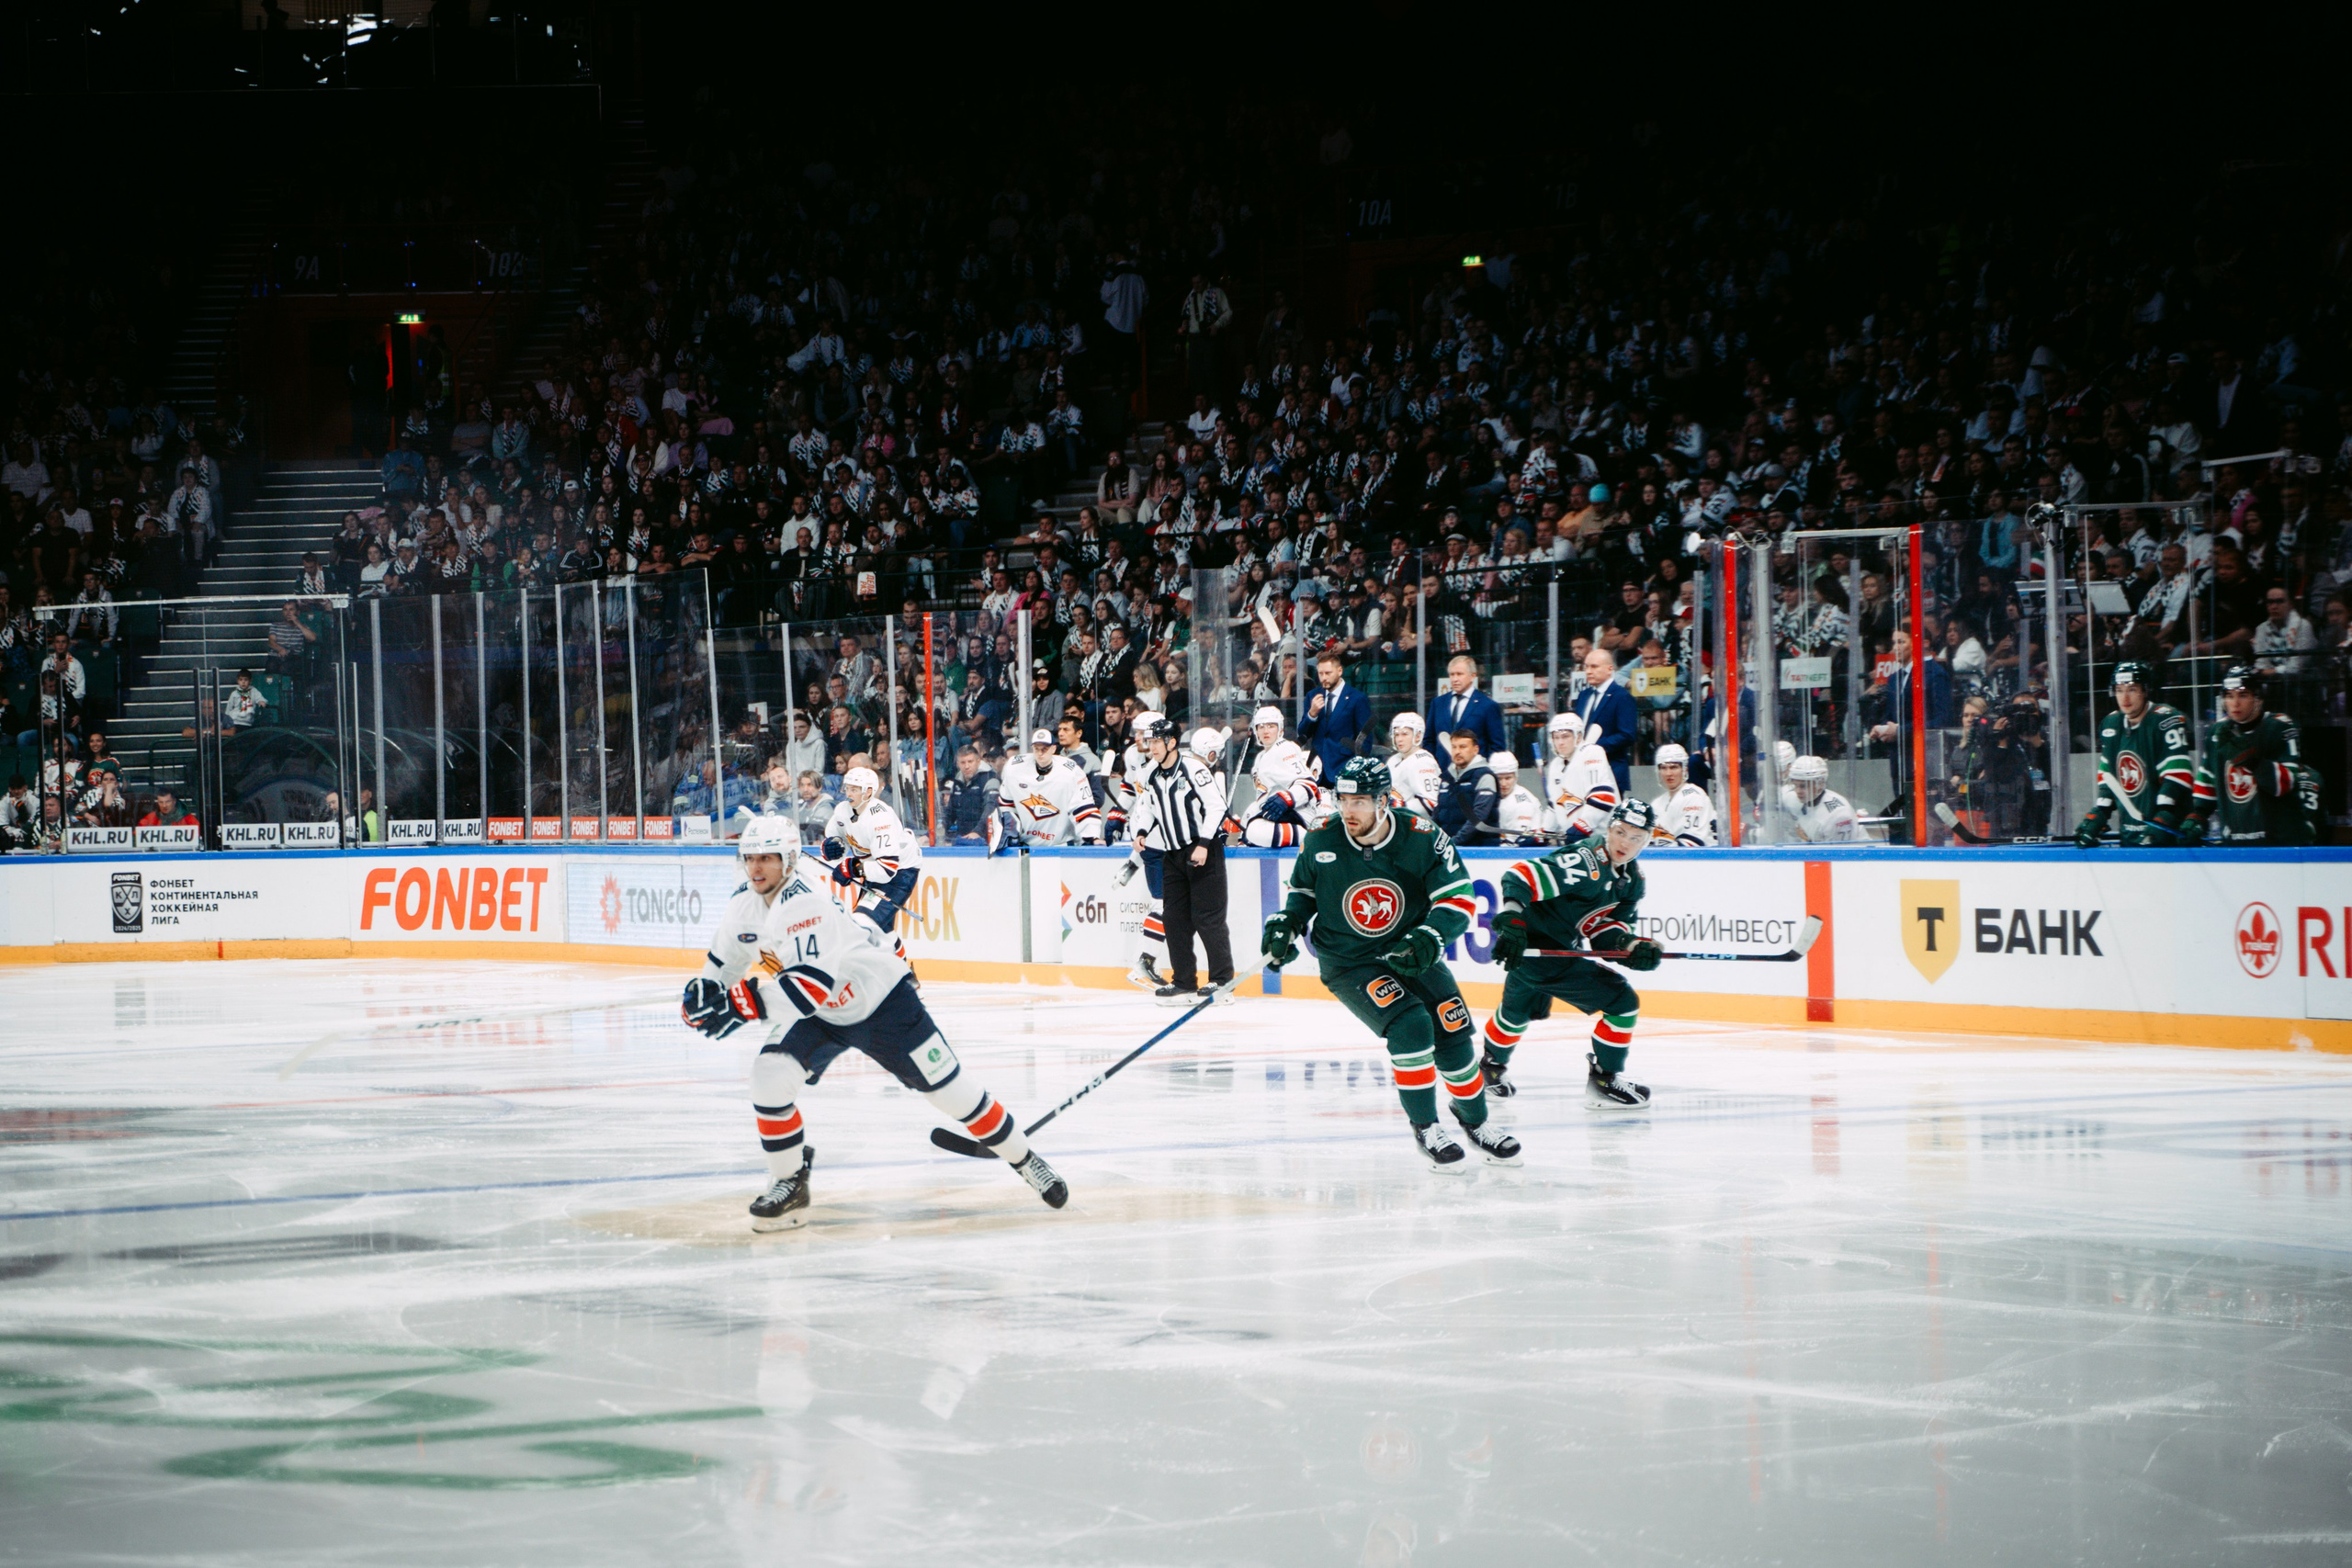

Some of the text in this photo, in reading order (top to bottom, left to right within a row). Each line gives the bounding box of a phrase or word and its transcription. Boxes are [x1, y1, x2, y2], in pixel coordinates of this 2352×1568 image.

[1791, 672, 1828, 682] TATNEFT
[1194, 768, 1212, 787] 85
[1423, 777, 1439, 793] 89
[226, 828, 277, 841] KHL.RU
[288, 826, 335, 840] KHL.RU
[391, 823, 433, 838] KHL.RU
[444, 822, 481, 837] KHL.RU
[488, 821, 524, 836] FONBET
[532, 820, 561, 836] FONBET
[571, 820, 599, 836] FONBET
[607, 820, 636, 836] FONBET
[644, 820, 673, 836] FONBET
[1026, 829, 1055, 841] FONBET
[71, 829, 129, 845] KHL.RU
[140, 829, 195, 843] KHL.RU
[876, 834, 891, 849] 72
[2012, 836, 2052, 844] CCM
[1555, 852, 1589, 885] 94
[112, 874, 140, 882] FONBET
[150, 879, 195, 888] ФОНБЕТ
[151, 891, 258, 900] КОНТИНЕНТАЛЬНАЯ
[360, 866, 548, 931] FONBET
[151, 902, 219, 913] ХОККЕЙНАЯ
[1076, 894, 1107, 924] сбп
[151, 916, 180, 925] ЛИГА
[786, 916, 823, 936] FONBET
[1975, 908, 2104, 956] БАНК
[795, 933, 820, 963] 14
[1686, 953, 1738, 961] CCM
[1376, 981, 1399, 998] Win
[1445, 1006, 1466, 1021] Win
